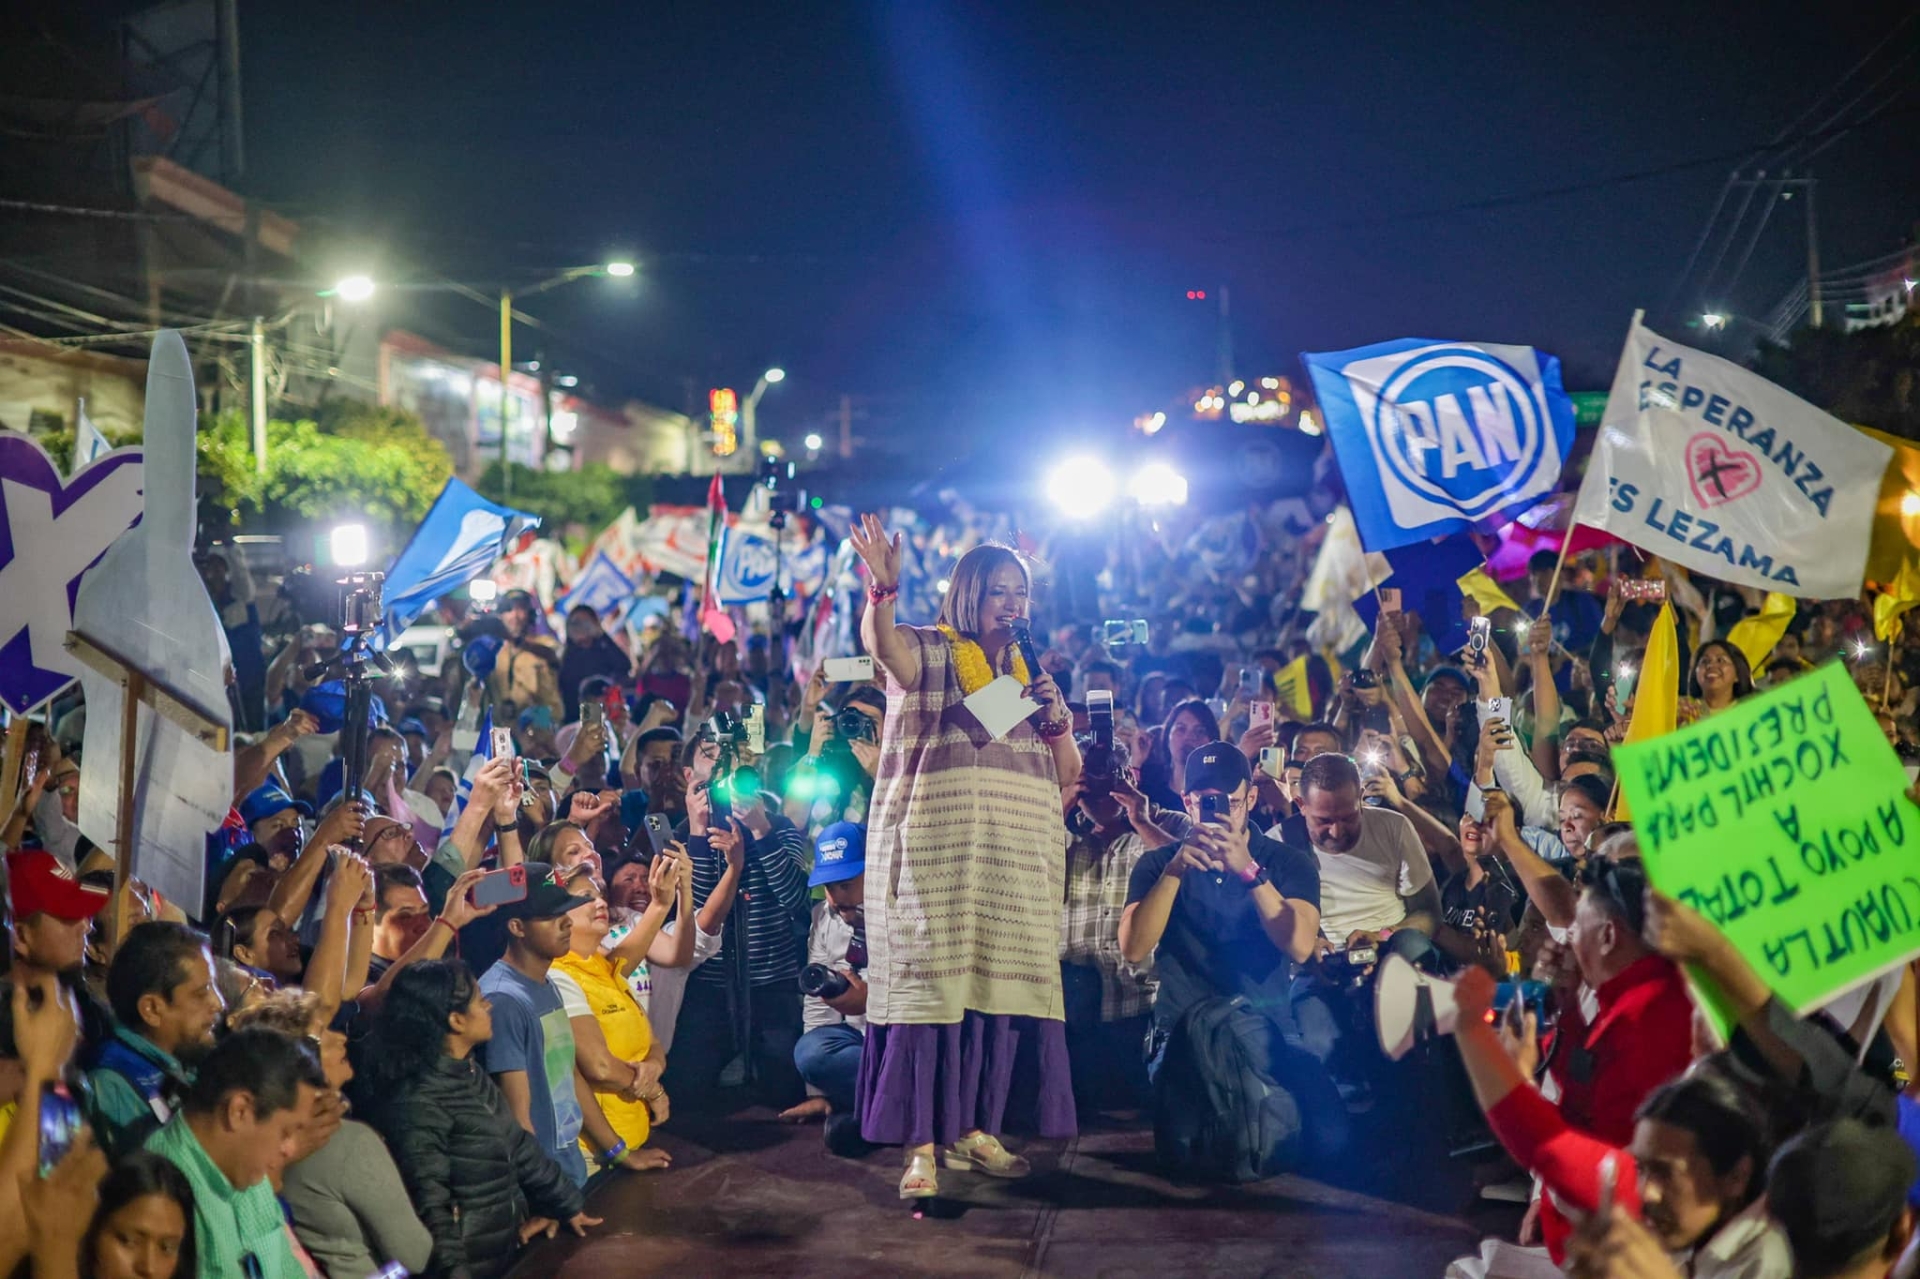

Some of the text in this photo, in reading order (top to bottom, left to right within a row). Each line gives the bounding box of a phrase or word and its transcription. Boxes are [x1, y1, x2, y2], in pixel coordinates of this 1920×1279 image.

[1643, 346, 1682, 380] LA
[1396, 381, 1522, 478] PAN
[1644, 498, 1800, 586] LEZAMA
[1678, 799, 1905, 926] APOYO TOTAL
[1773, 804, 1801, 844] A
